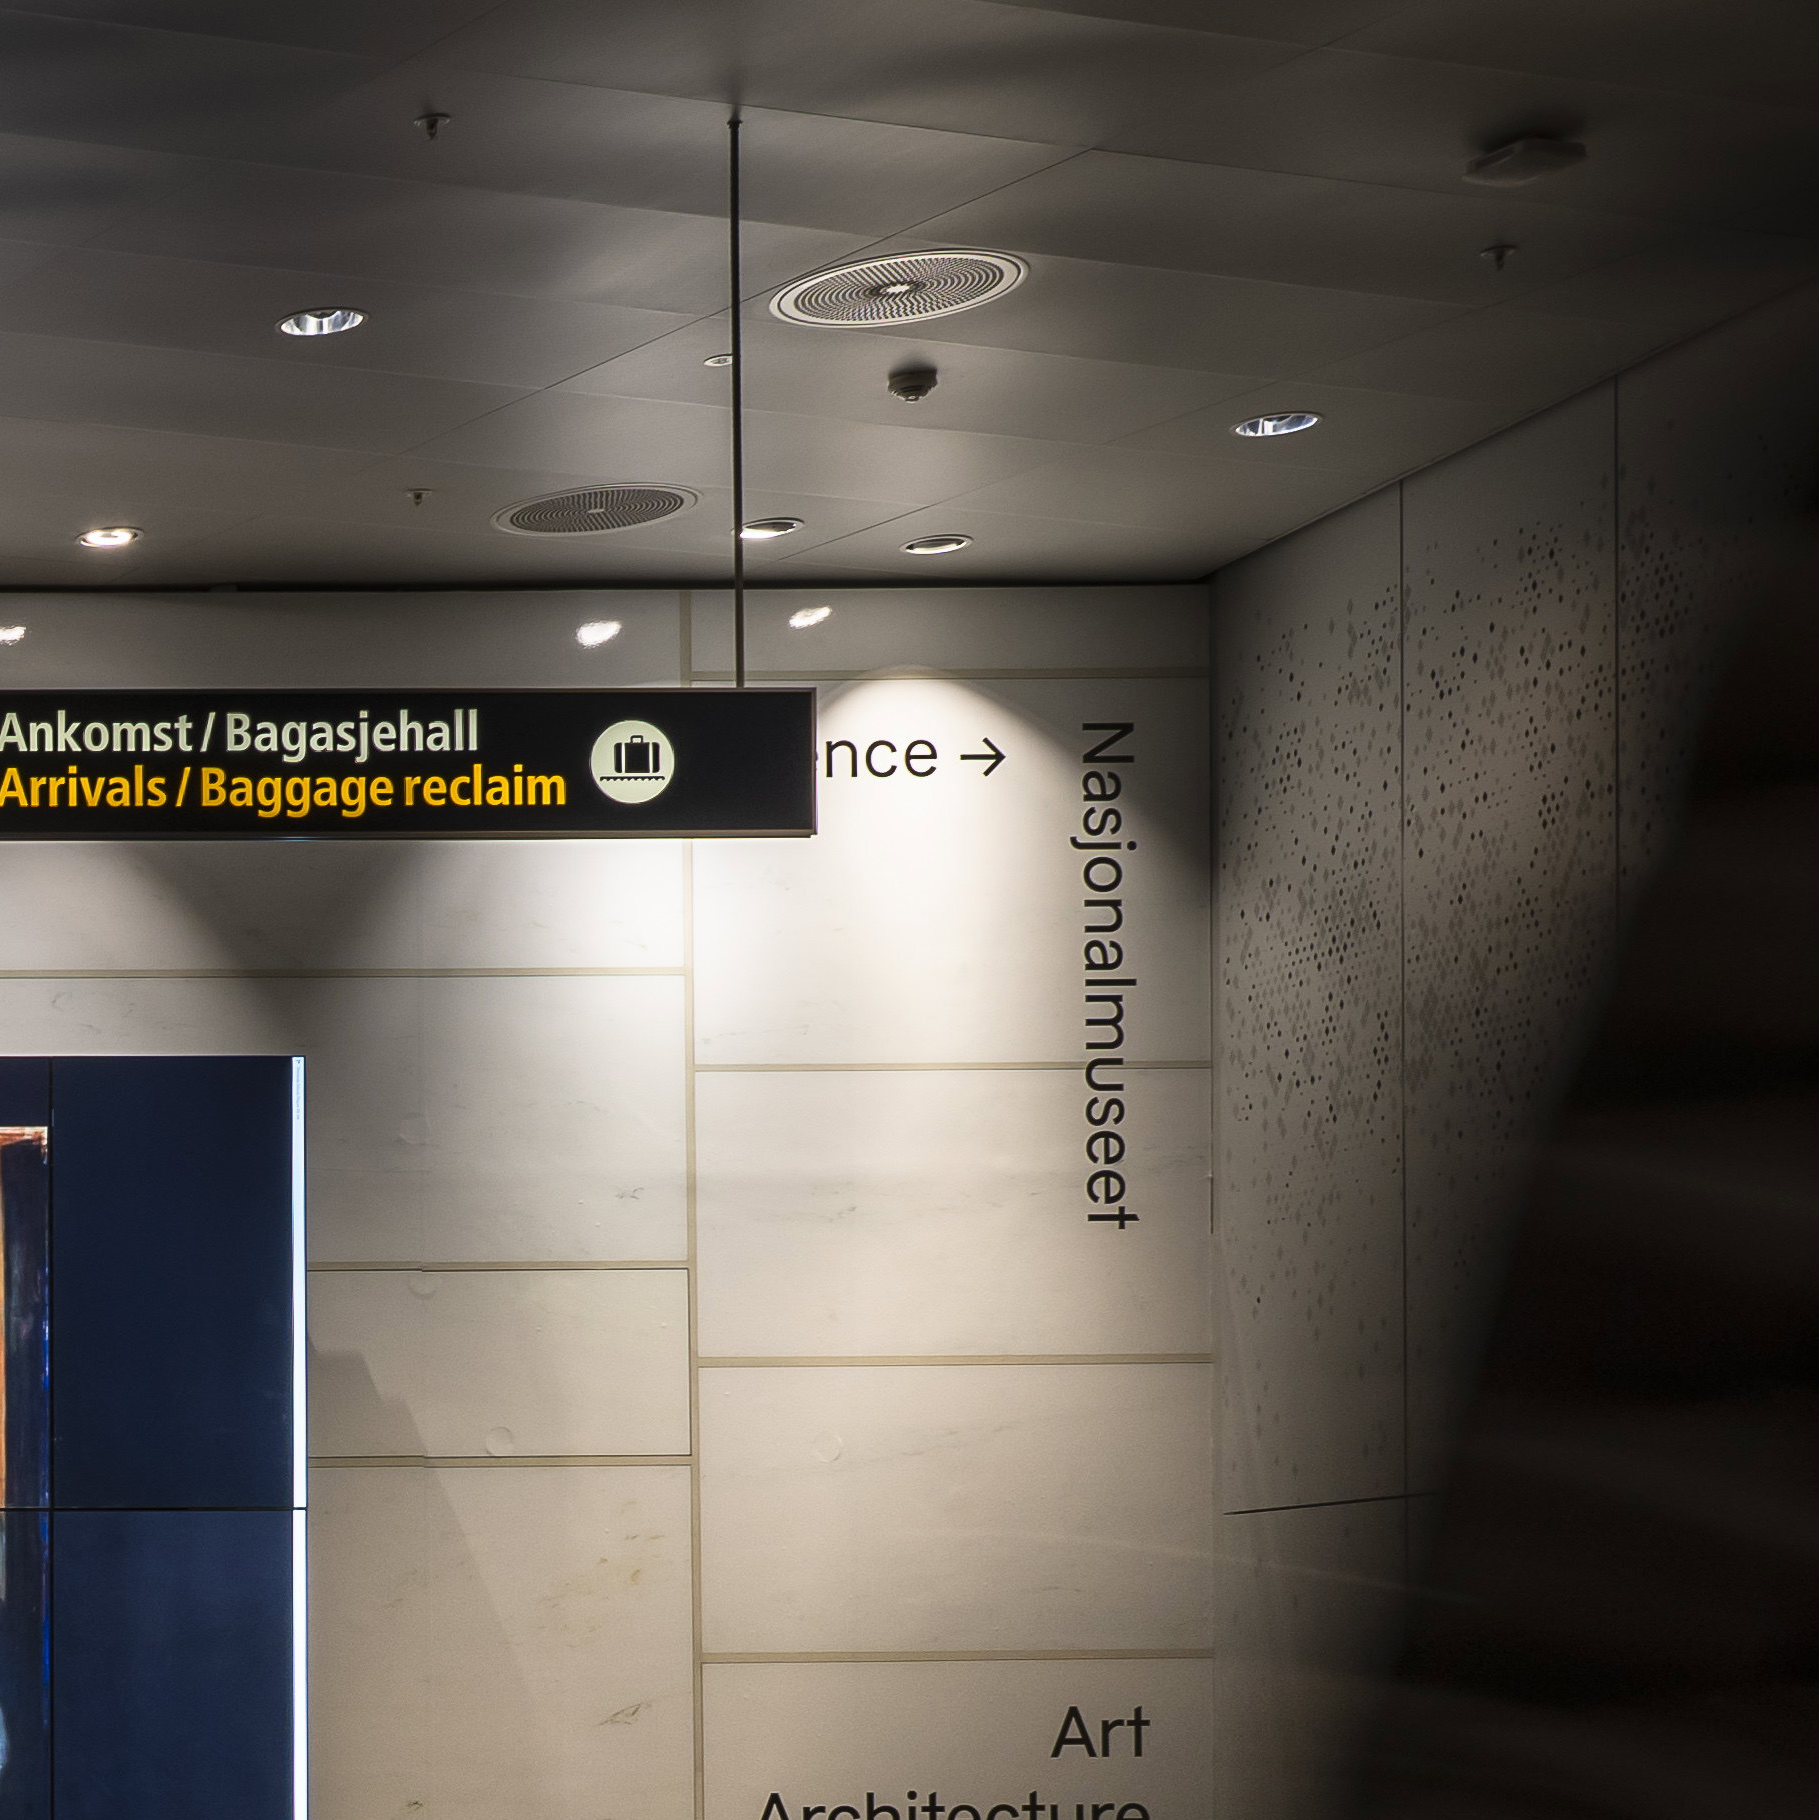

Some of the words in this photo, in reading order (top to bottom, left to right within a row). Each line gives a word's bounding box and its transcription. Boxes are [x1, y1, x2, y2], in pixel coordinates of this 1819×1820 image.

[226, 708, 478, 764] Bagasjehall
[816, 739, 939, 778] nce
[201, 767, 394, 818] Baggage
[404, 763, 566, 808] reclaim
[1069, 721, 1140, 1231] Nasjonalmuseet
[1050, 1705, 1151, 1758] Art
